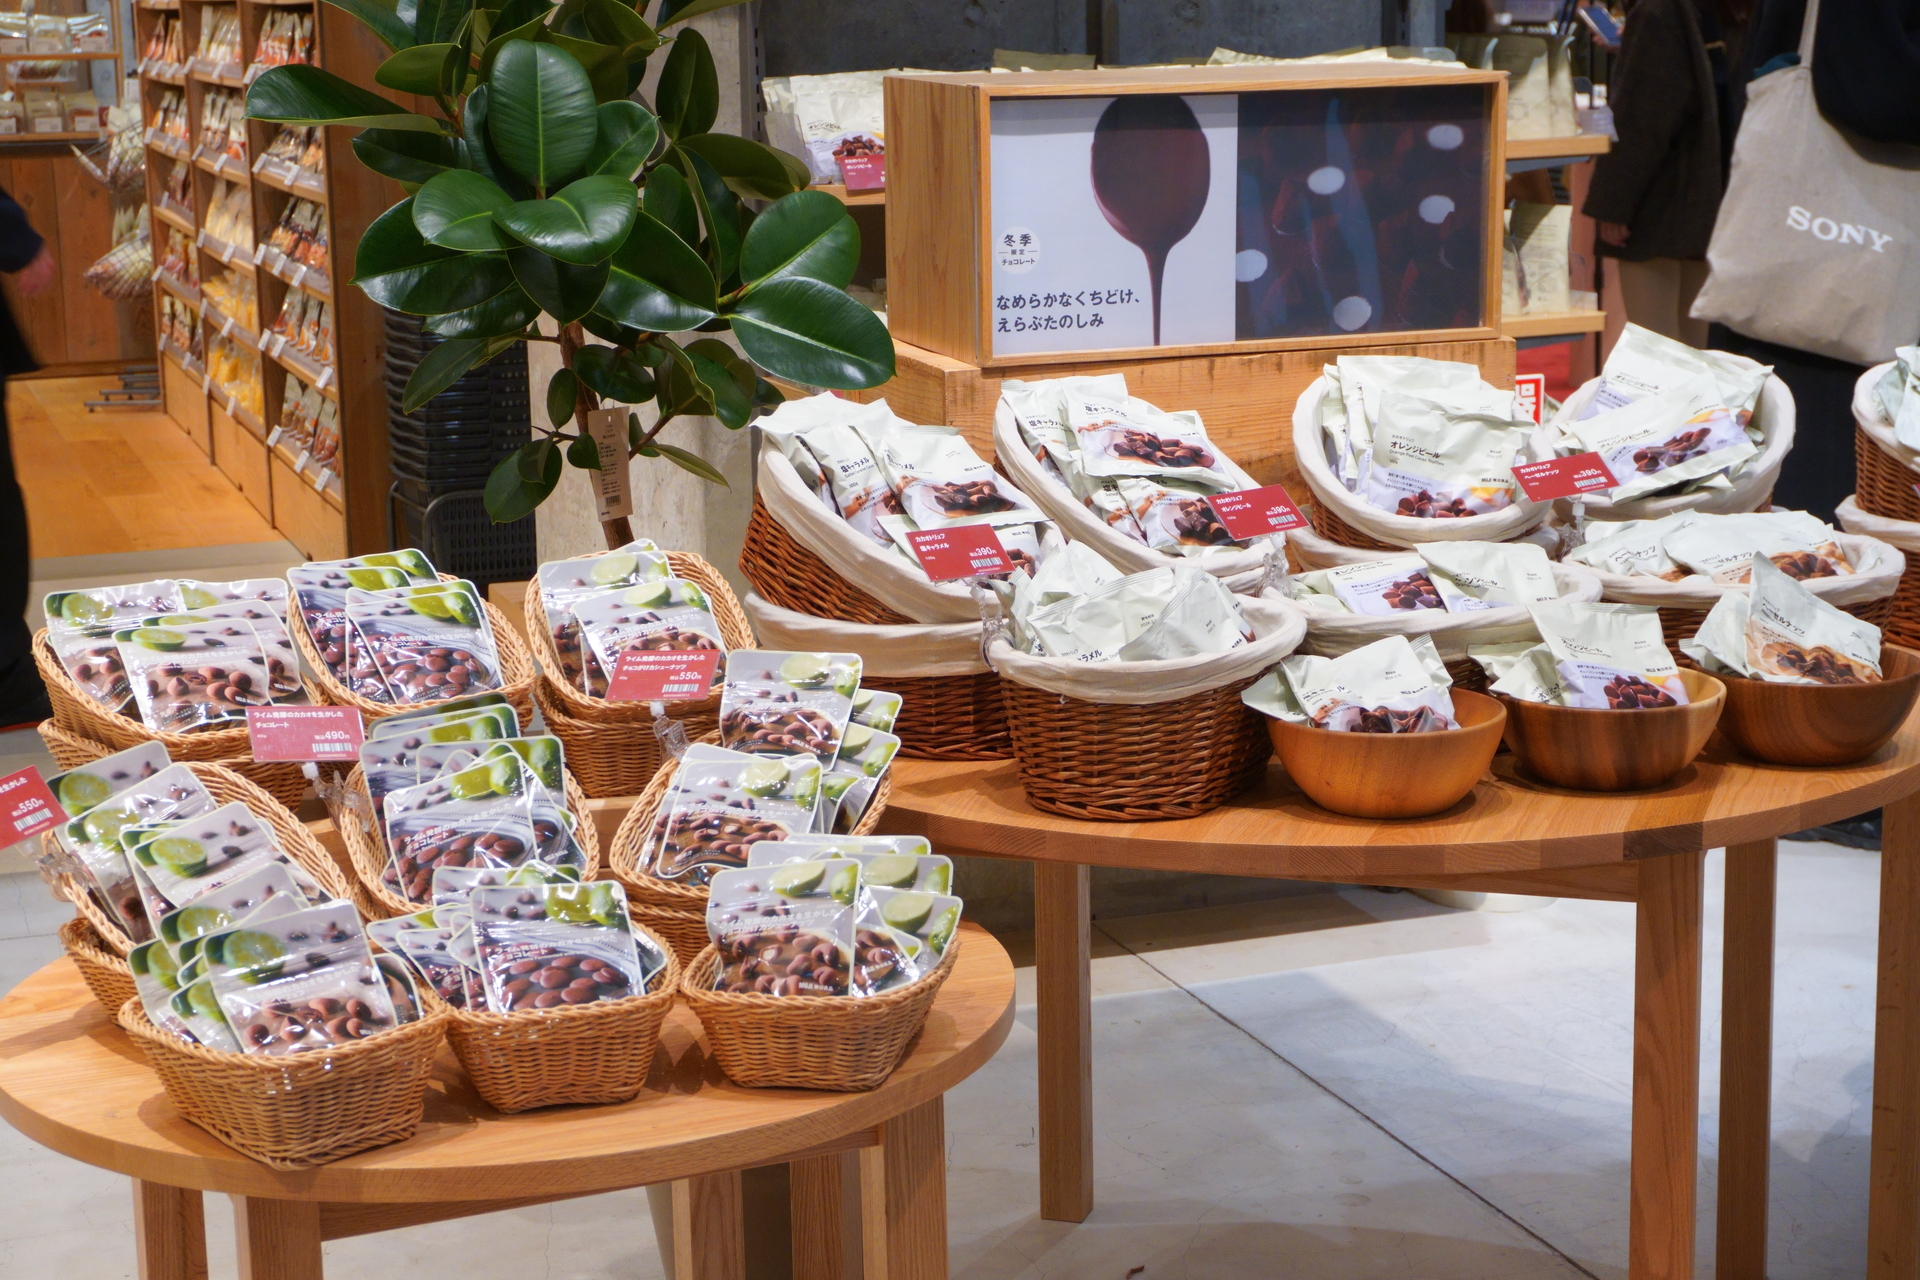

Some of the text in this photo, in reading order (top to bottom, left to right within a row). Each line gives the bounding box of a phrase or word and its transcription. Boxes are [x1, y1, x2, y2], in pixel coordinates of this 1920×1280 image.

[1786, 206, 1893, 253] SONY
[1004, 233, 1032, 247] 冬季
[1002, 257, 1035, 266] チョコレート
[996, 289, 1140, 310] なめらかなくちどけ、
[997, 313, 1104, 333] えらぶたのしみ
[915, 533, 945, 543] カカオトリュフ
[919, 543, 950, 552] 塩キャラメル
[625, 654, 706, 662] ライム発酵のカカオを生かした
[669, 671, 702, 681] 税込550円
[253, 711, 344, 719] ライム発酵のカカオを生かした
[255, 721, 289, 729] チョコレート
[314, 730, 350, 740] 税込490円
[798, 981, 814, 990] MUJI
